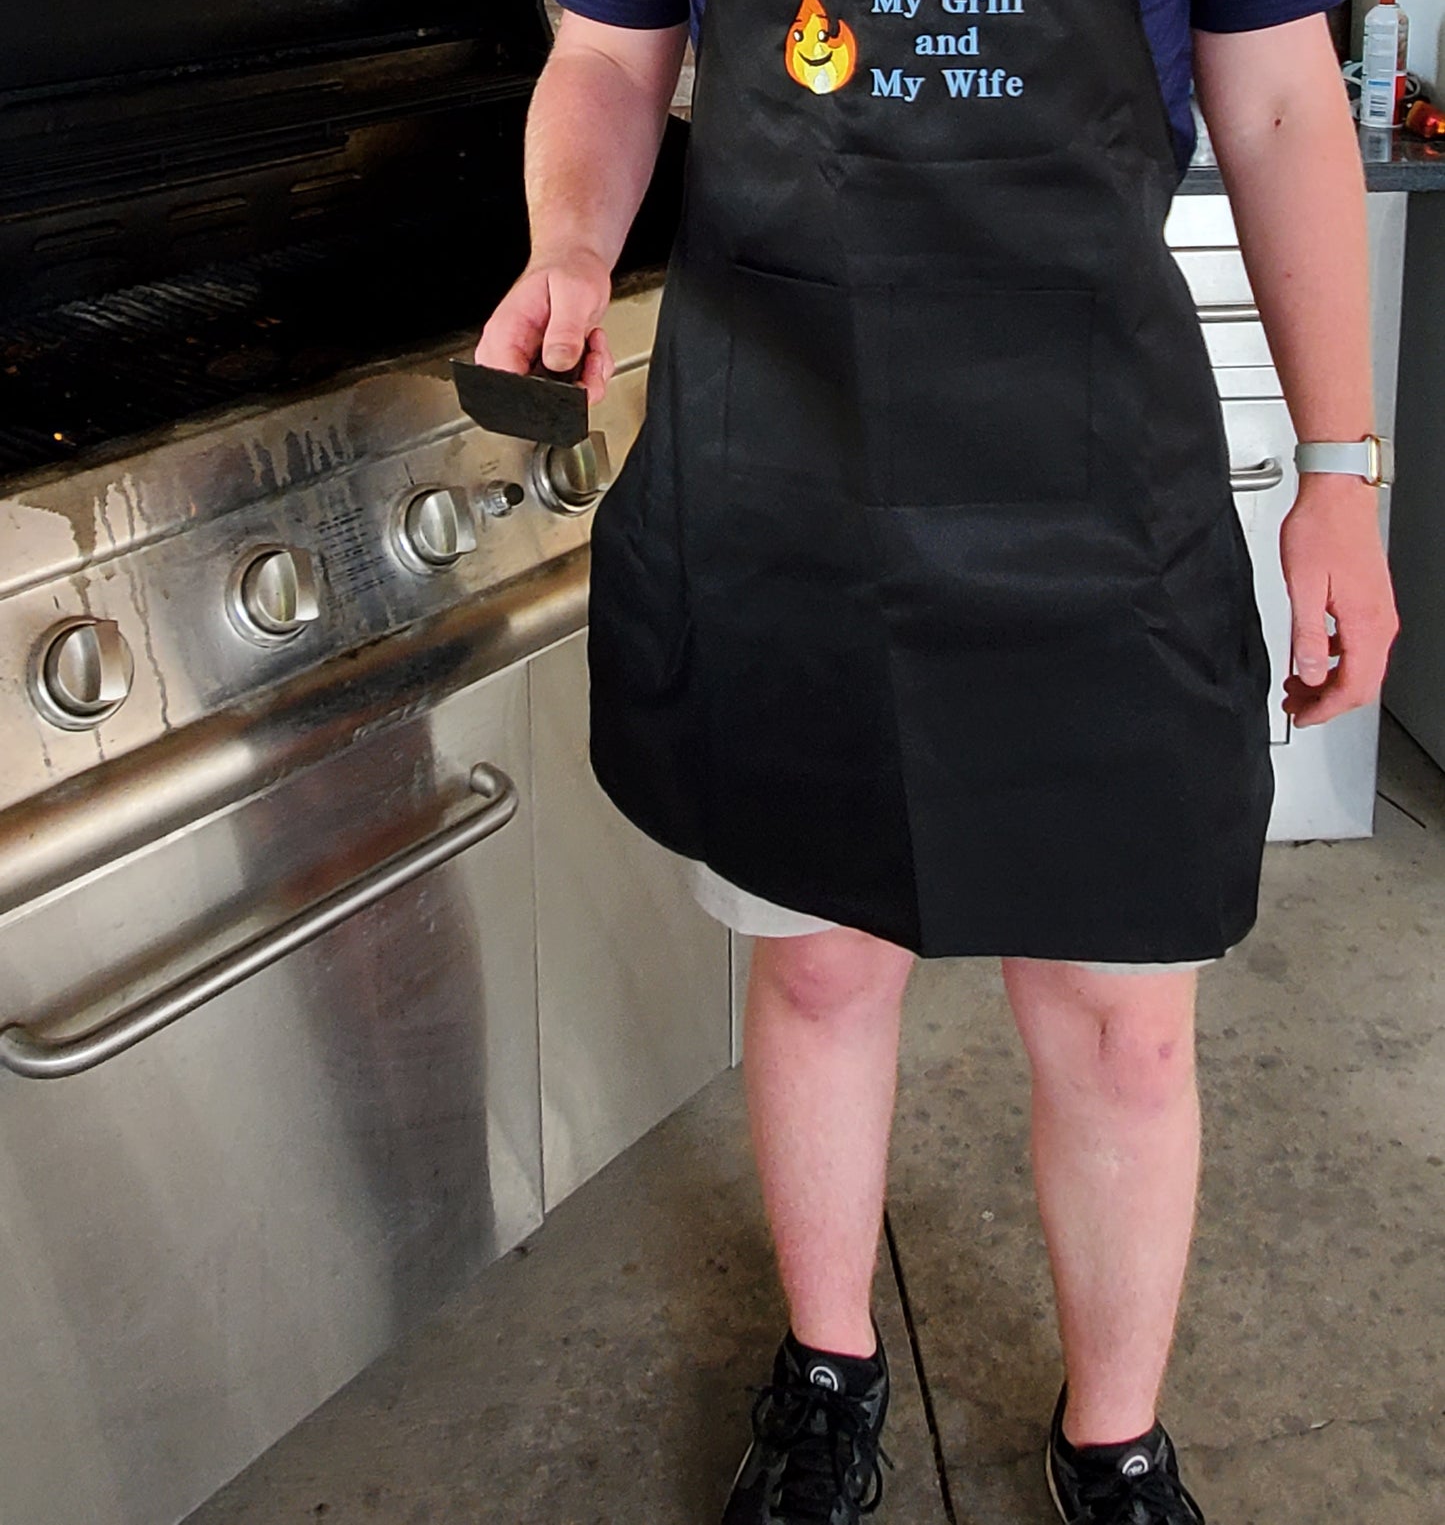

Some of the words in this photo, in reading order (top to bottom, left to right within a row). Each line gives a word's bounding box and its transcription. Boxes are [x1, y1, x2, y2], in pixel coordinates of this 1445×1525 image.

[915, 26, 980, 56] and
[870, 68, 926, 103] My
[941, 68, 1025, 98] Wife
